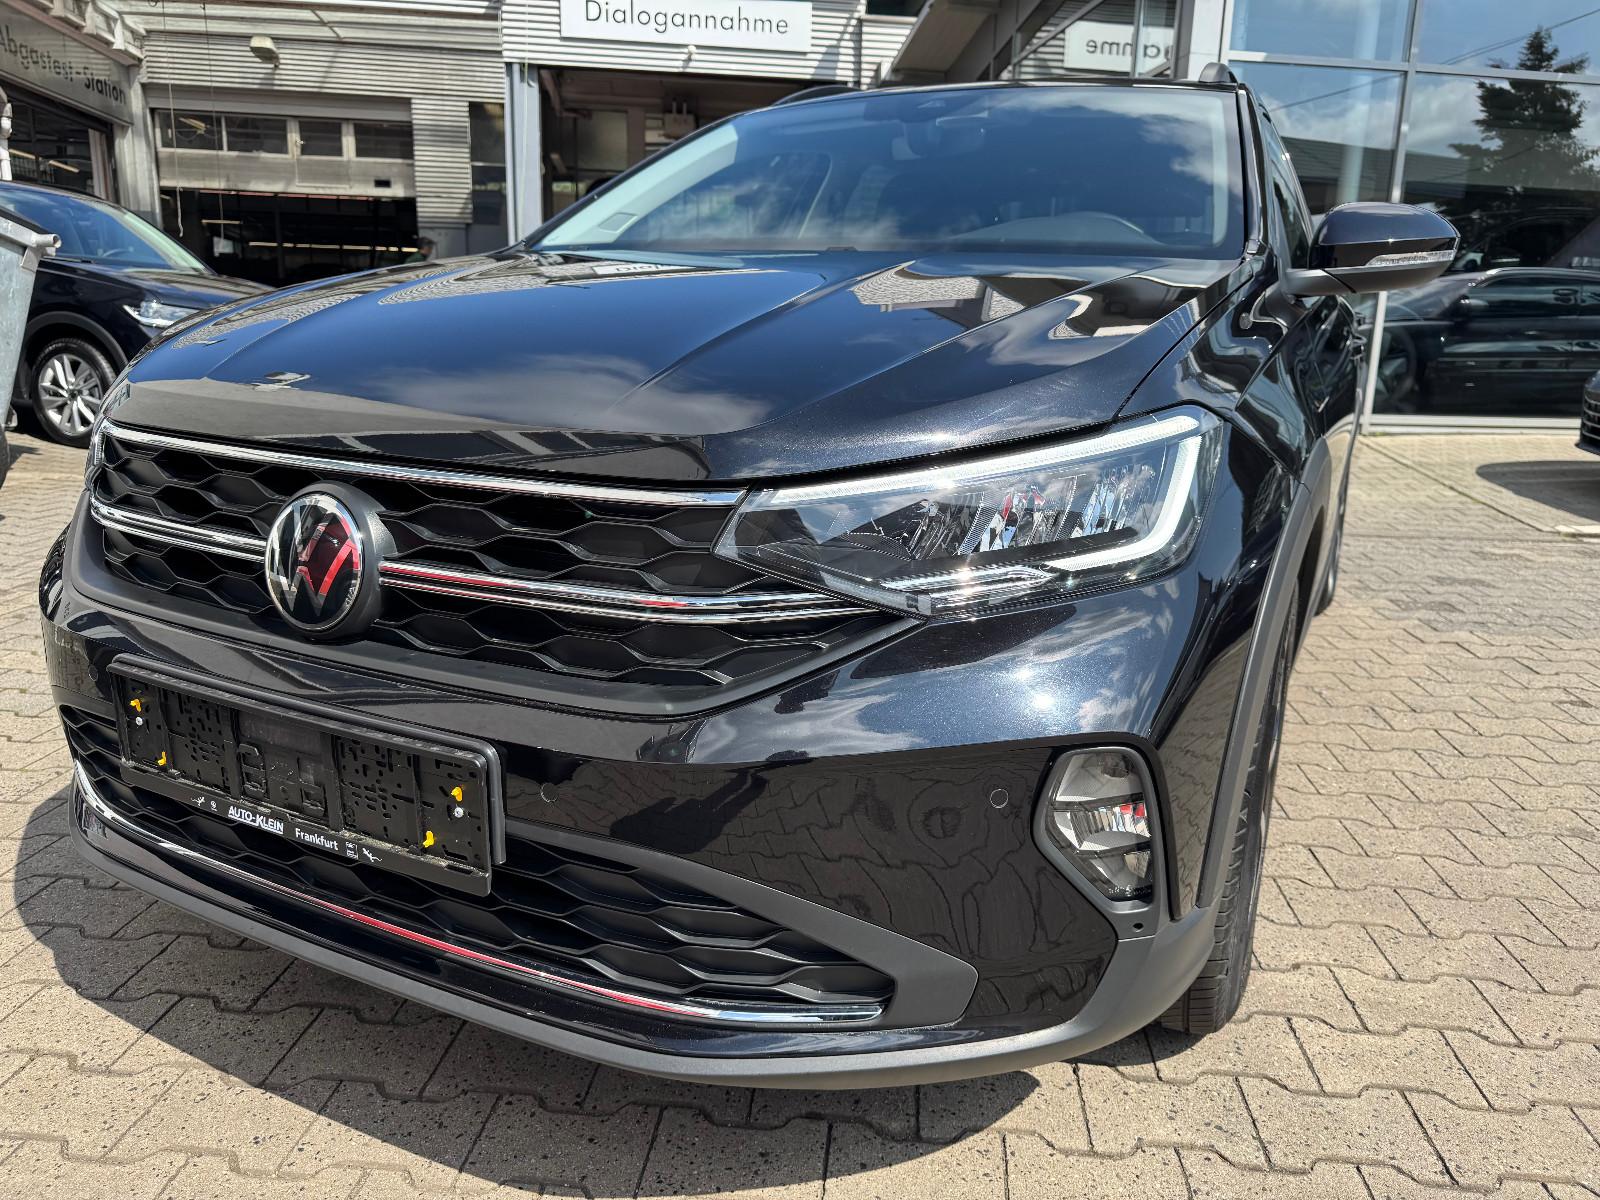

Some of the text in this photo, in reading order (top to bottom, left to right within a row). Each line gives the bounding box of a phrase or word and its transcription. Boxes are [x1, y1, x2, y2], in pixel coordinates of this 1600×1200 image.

[585, 0, 788, 33] Dialogannahme
[227, 805, 284, 835] AUTO-KLEIN
[295, 827, 339, 851] Frankfurt
